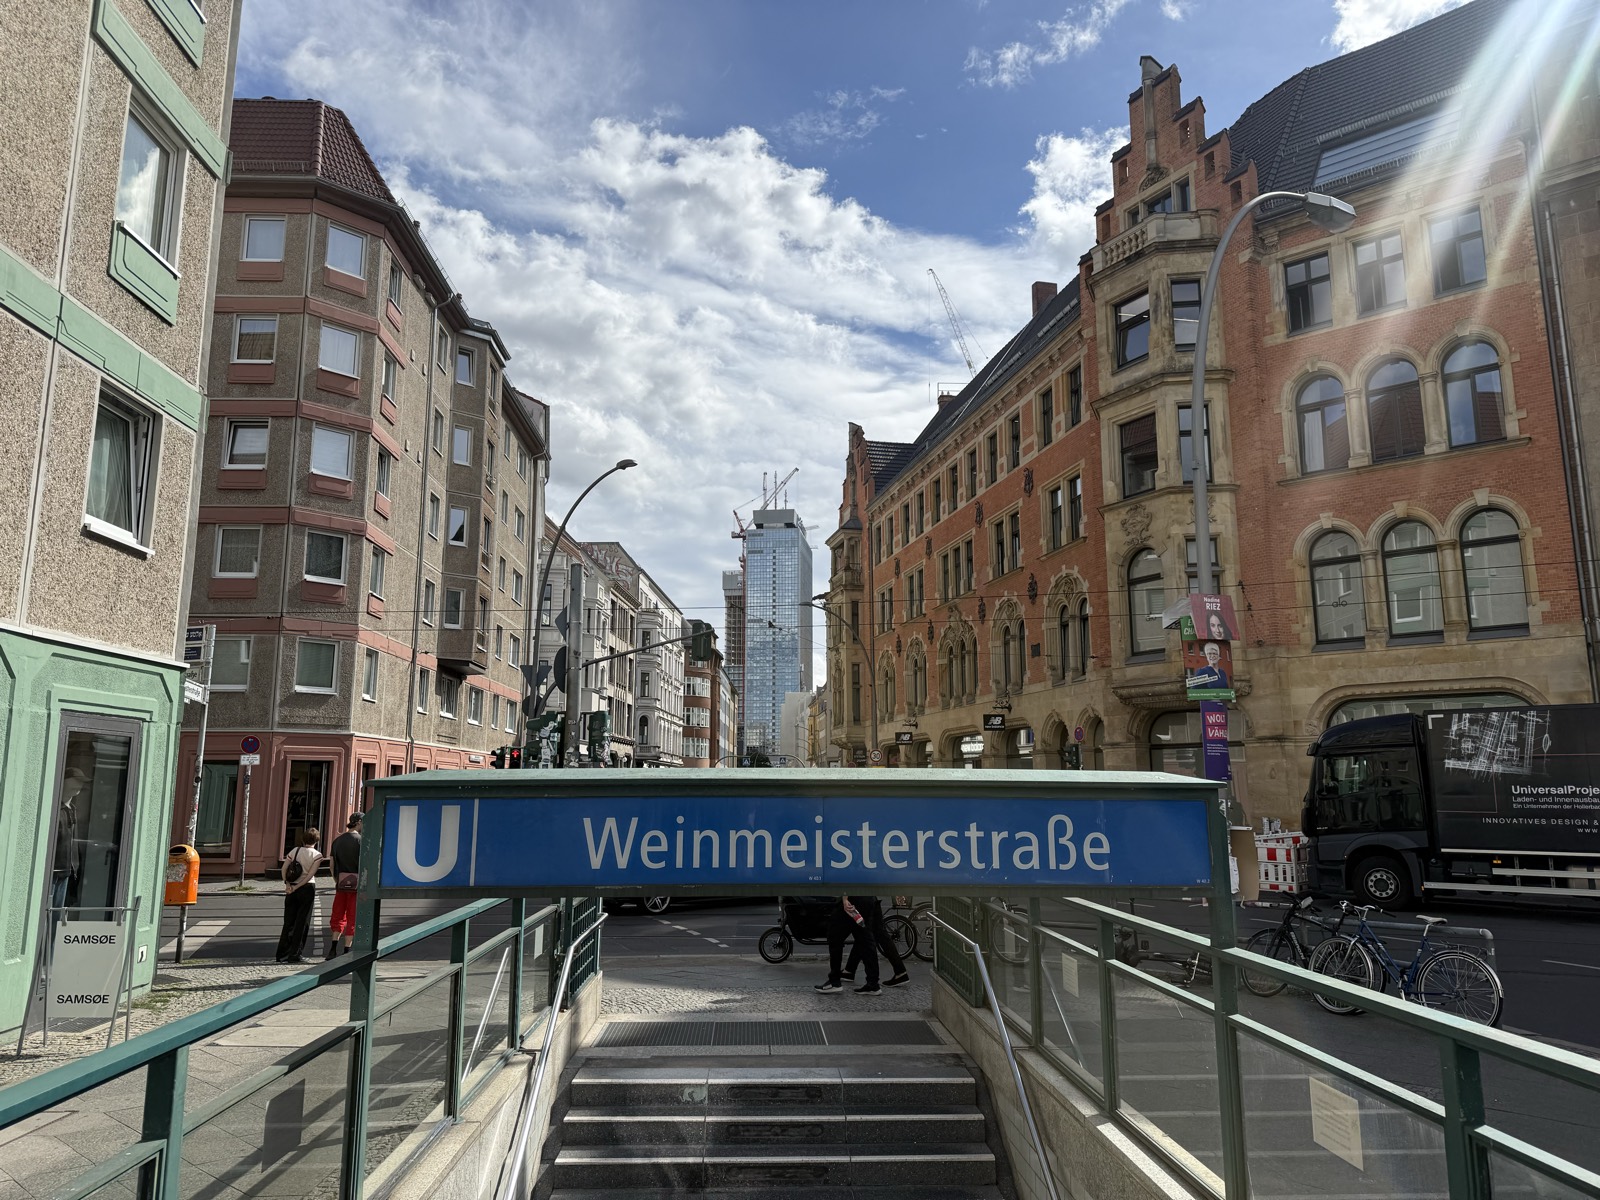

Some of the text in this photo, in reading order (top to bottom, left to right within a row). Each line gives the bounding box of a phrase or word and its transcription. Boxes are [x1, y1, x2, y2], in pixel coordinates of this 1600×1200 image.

[1205, 603, 1221, 611] RIEZ
[1482, 817, 1547, 825] INNOVATIVES
[397, 805, 461, 883] U
[583, 814, 1111, 871] Weinmeisterstraße
[63, 934, 117, 944] SAMSØE
[56, 994, 110, 1004] SAMSØE
